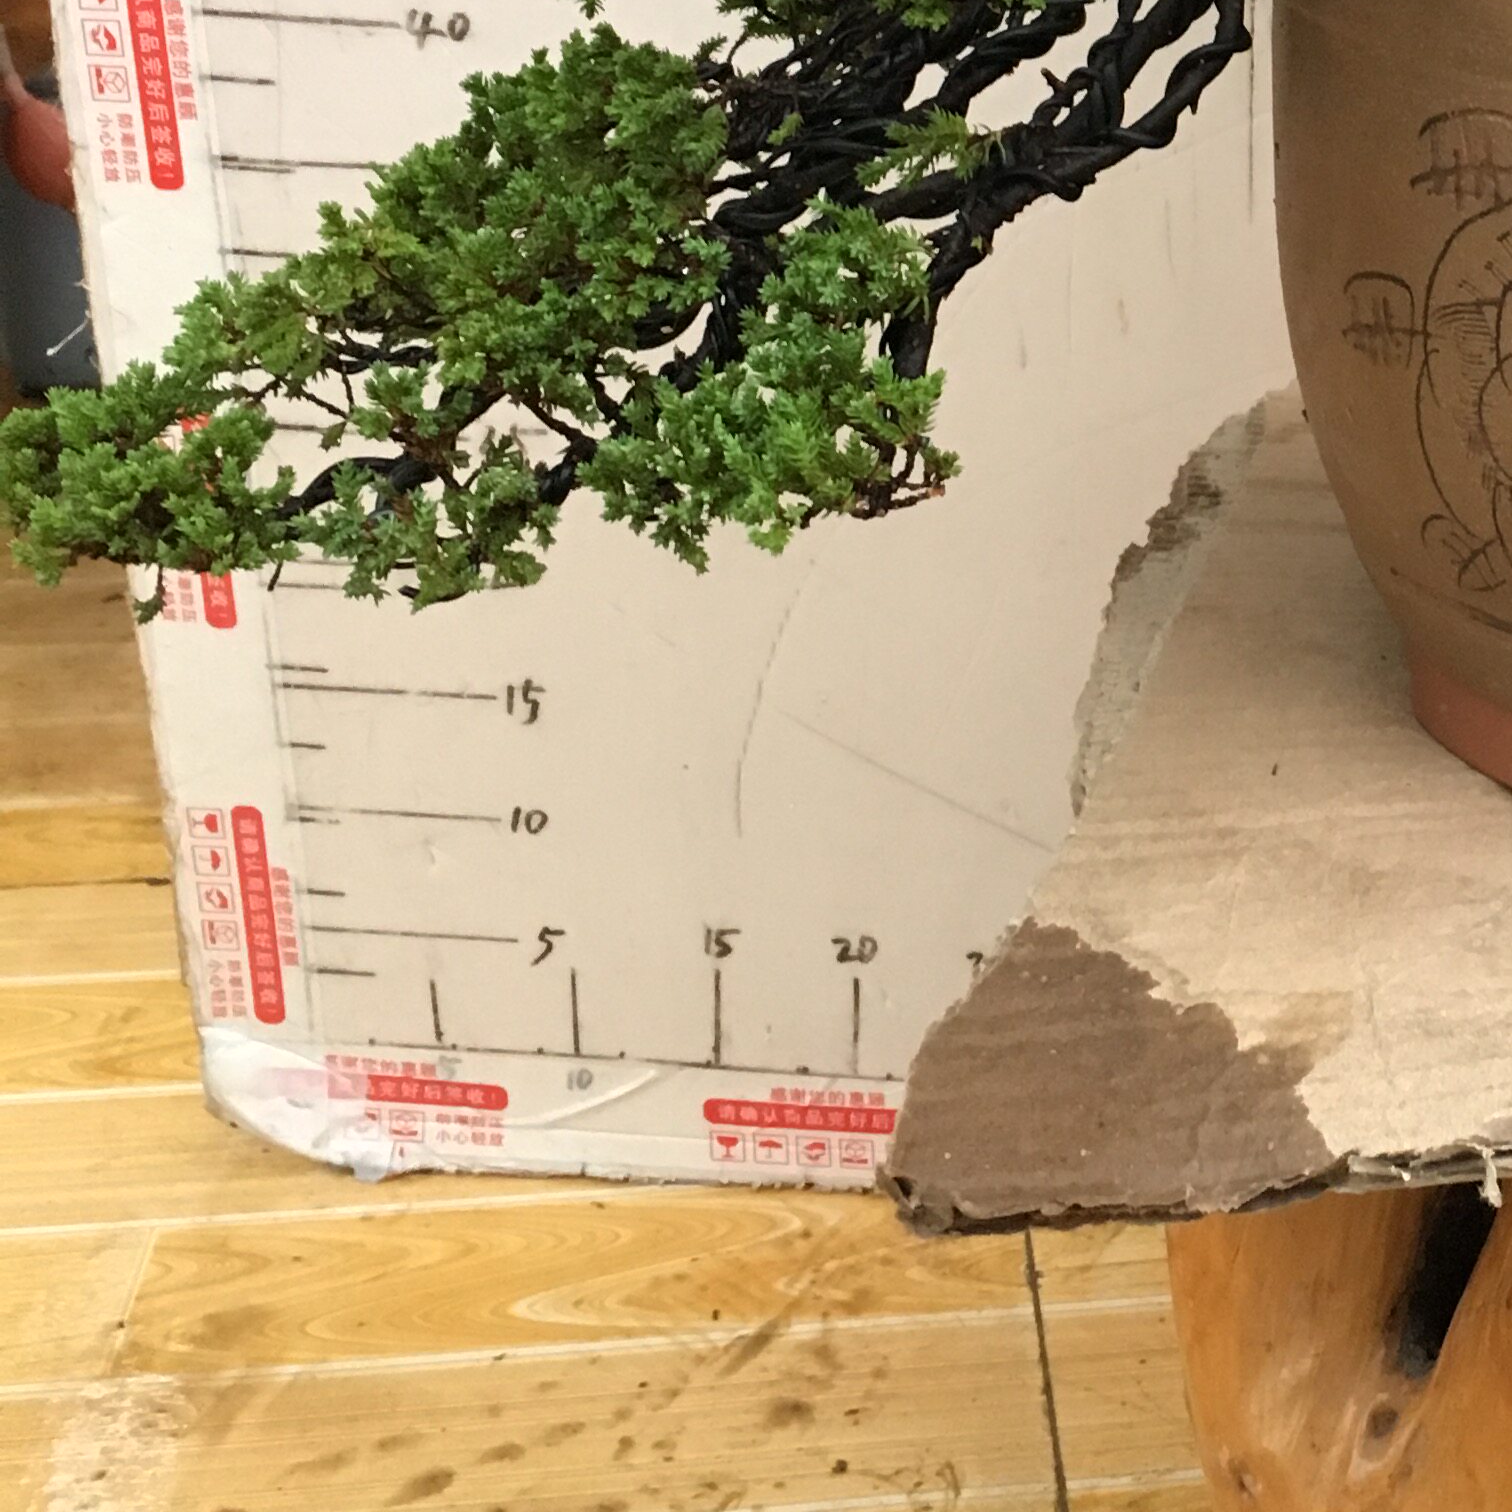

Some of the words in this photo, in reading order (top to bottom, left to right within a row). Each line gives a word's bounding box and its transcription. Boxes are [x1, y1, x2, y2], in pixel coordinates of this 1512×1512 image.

[406, 8, 470, 50] 40
[506, 678, 546, 725] 15
[511, 806, 549, 834] 10
[531, 926, 565, 966] 5
[704, 928, 741, 958] 15
[831, 935, 878, 963] 20
[566, 1067, 594, 1090] 10
